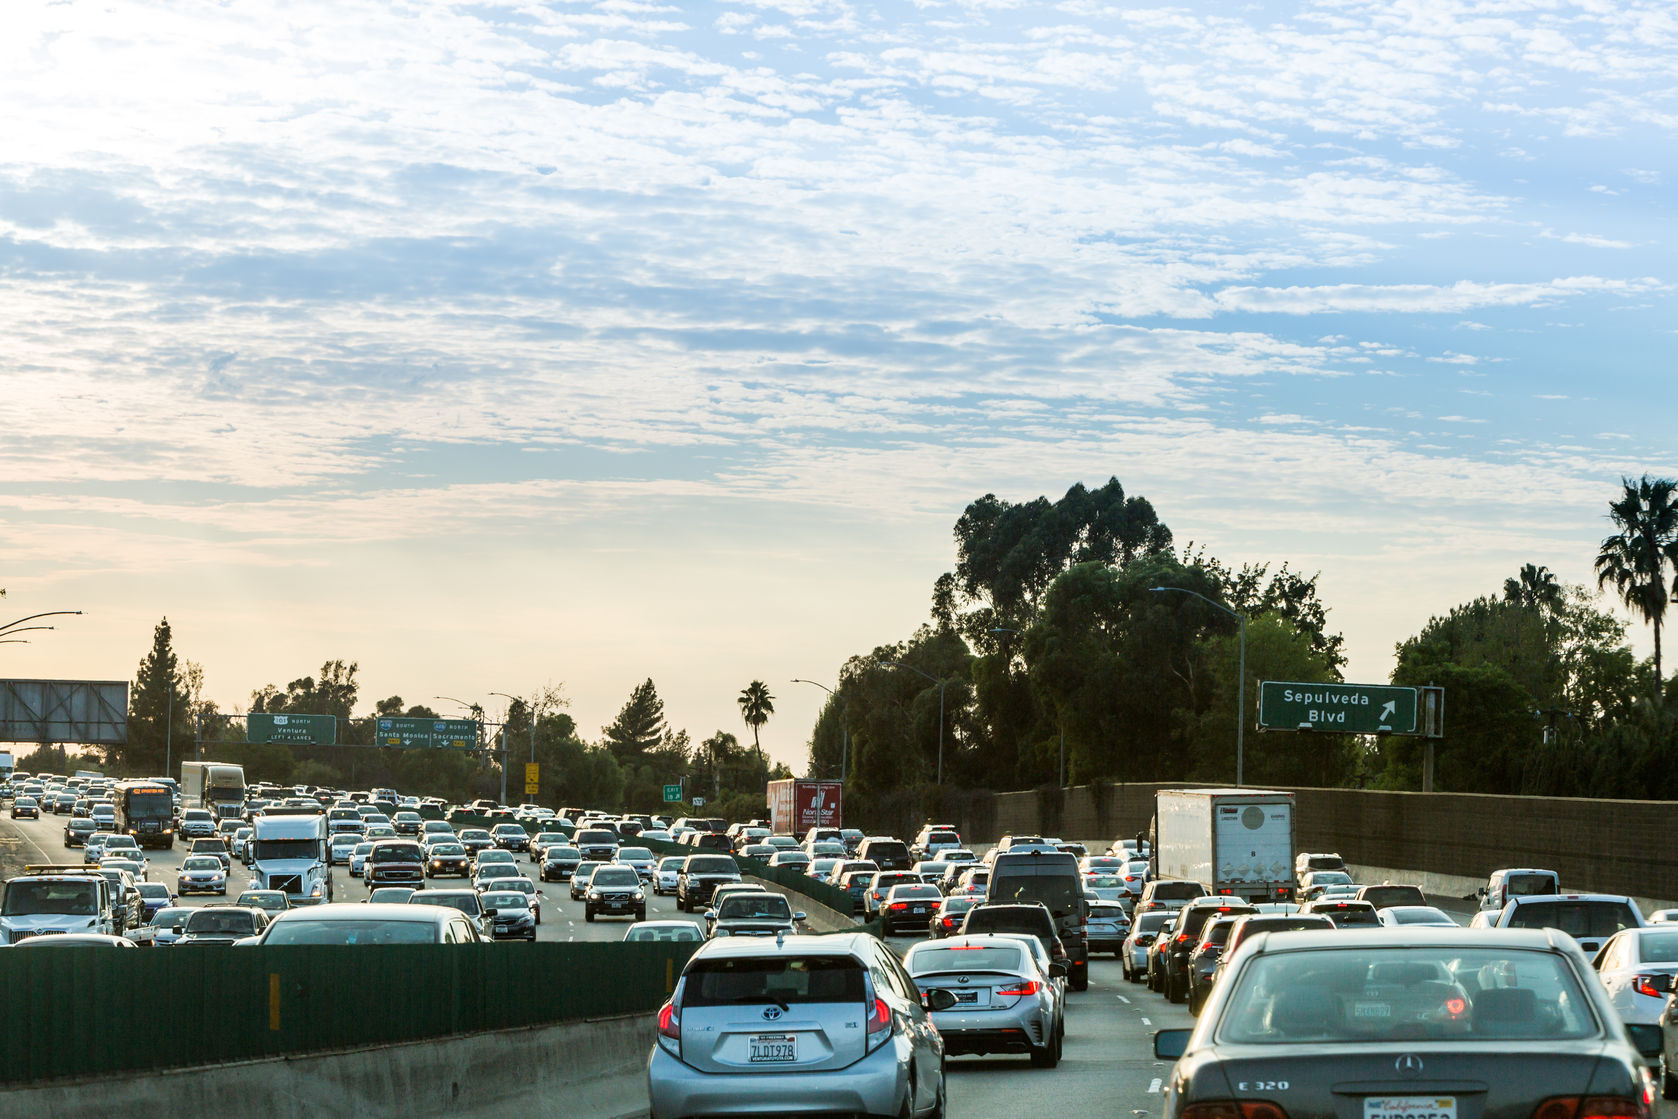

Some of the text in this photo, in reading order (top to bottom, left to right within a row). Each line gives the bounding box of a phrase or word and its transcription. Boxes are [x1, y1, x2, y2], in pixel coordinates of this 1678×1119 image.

[1284, 690, 1369, 705] Sepulveda
[1308, 709, 1346, 723] Blvd
[432, 733, 476, 741] Sacramento
[751, 1045, 793, 1057] 7LDT978
[1239, 1081, 1290, 1090] E 320
[1384, 1100, 1438, 1113] California
